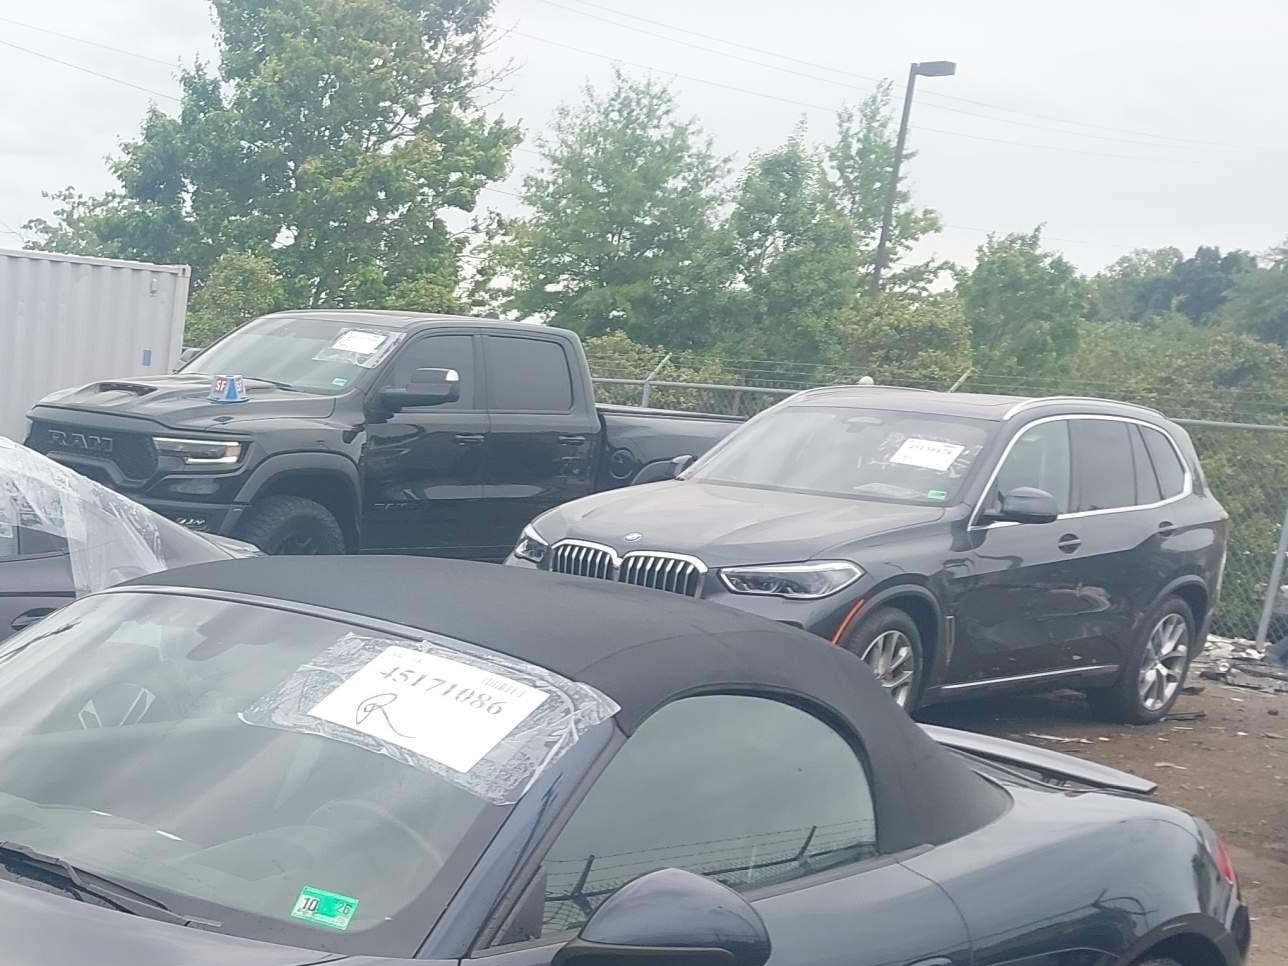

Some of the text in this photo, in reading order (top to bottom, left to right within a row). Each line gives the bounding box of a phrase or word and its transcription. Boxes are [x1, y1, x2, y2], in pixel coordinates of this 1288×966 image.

[47, 428, 113, 452] RAM
[379, 665, 506, 717] 45171086
[302, 897, 353, 915] 10 26
